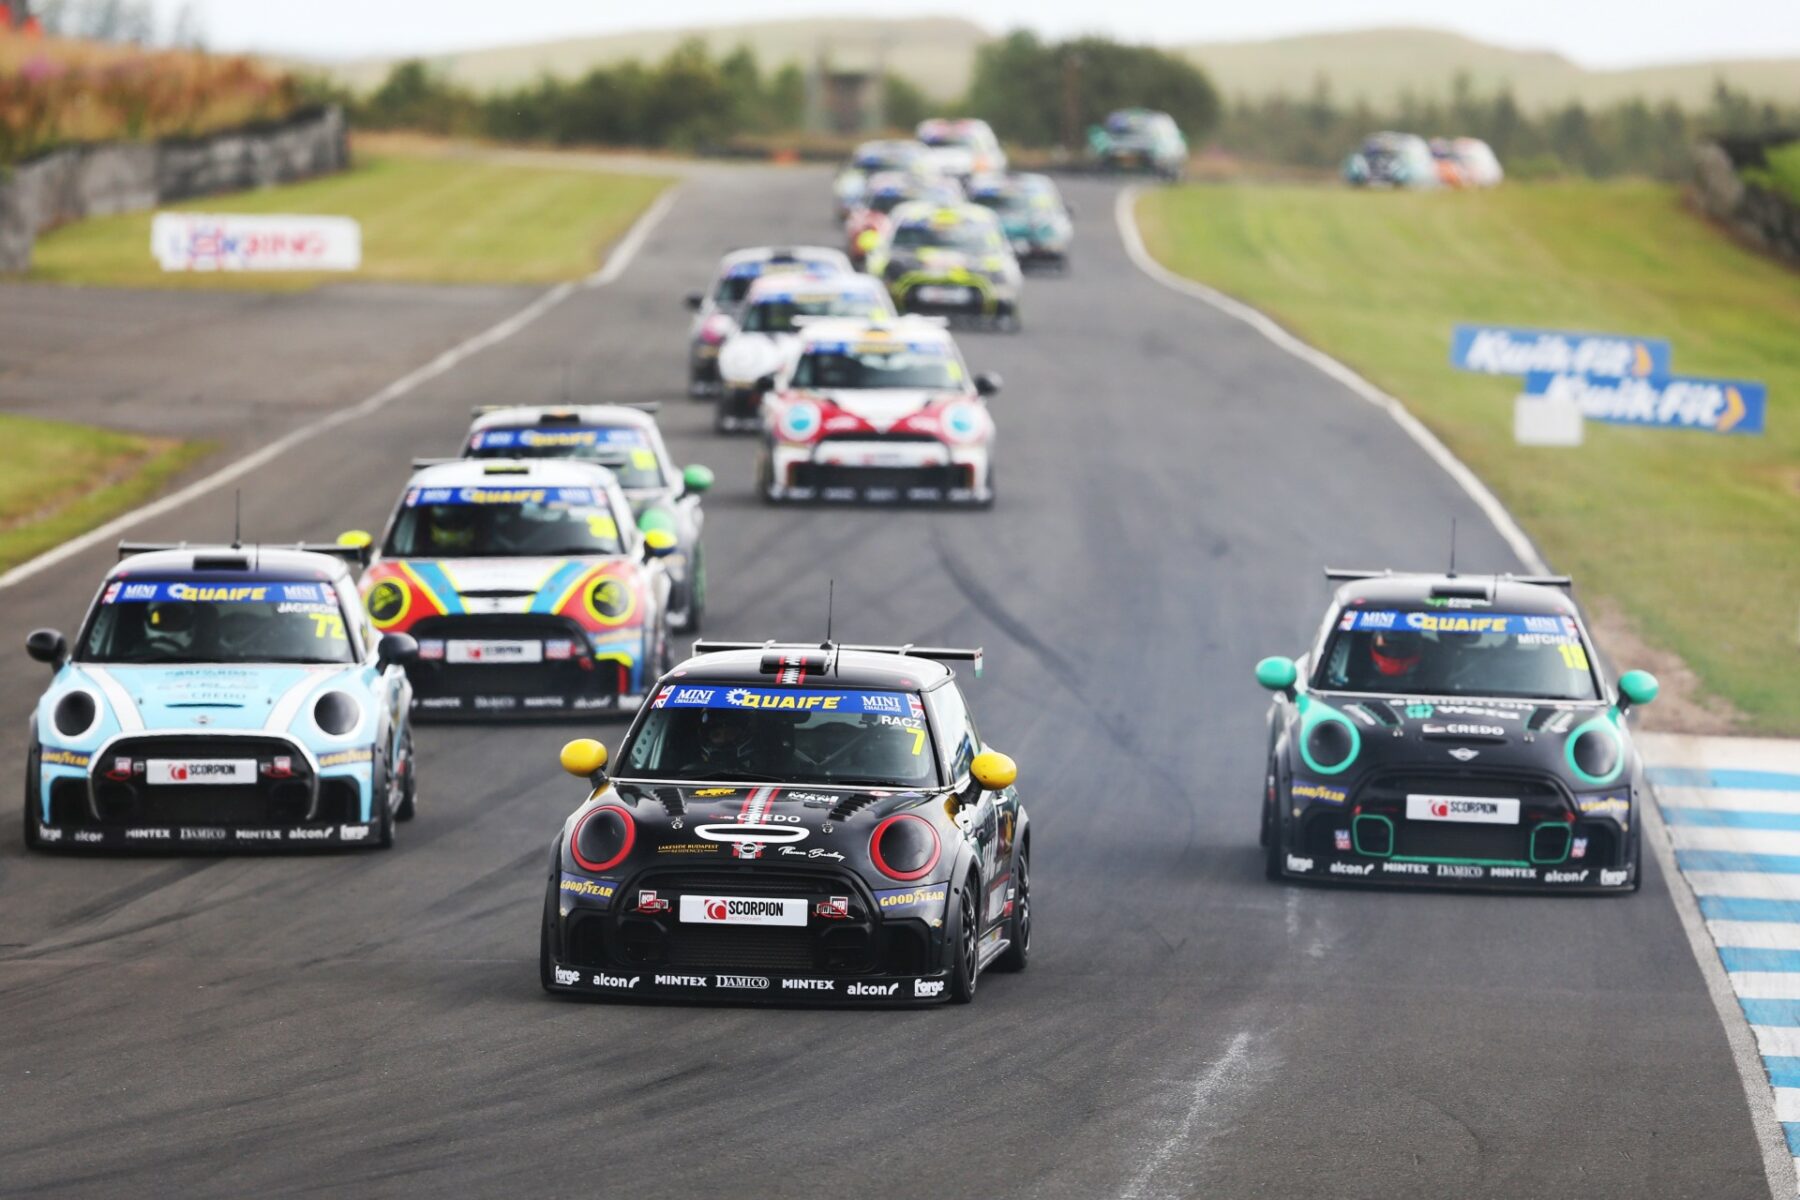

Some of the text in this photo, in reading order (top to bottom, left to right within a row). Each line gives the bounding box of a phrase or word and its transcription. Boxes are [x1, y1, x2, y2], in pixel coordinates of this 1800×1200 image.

[183, 587, 267, 602] QUAIFE
[1423, 617, 1508, 632] QUAIFE
[677, 689, 901, 710] MINI QUAIFE MINI
[863, 705, 902, 713] CHALLENGE
[881, 715, 922, 729] RACZ
[1447, 723, 1505, 736] CREDO
[906, 727, 926, 756] 7
[189, 763, 236, 775] SCORPION
[1450, 801, 1498, 814] SCORPION
[1382, 862, 1429, 875] MINTEX
[1490, 867, 1537, 879] MINTEX
[560, 880, 614, 898] GOODYEAR
[879, 889, 945, 907] GOODYEAR
[728, 900, 784, 917] SCORPION
[592, 972, 628, 988] alcon
[654, 974, 708, 987] MINTEX
[716, 974, 770, 989] DAMICO
[781, 978, 835, 990] MINTEX
[847, 982, 888, 996] alcon
